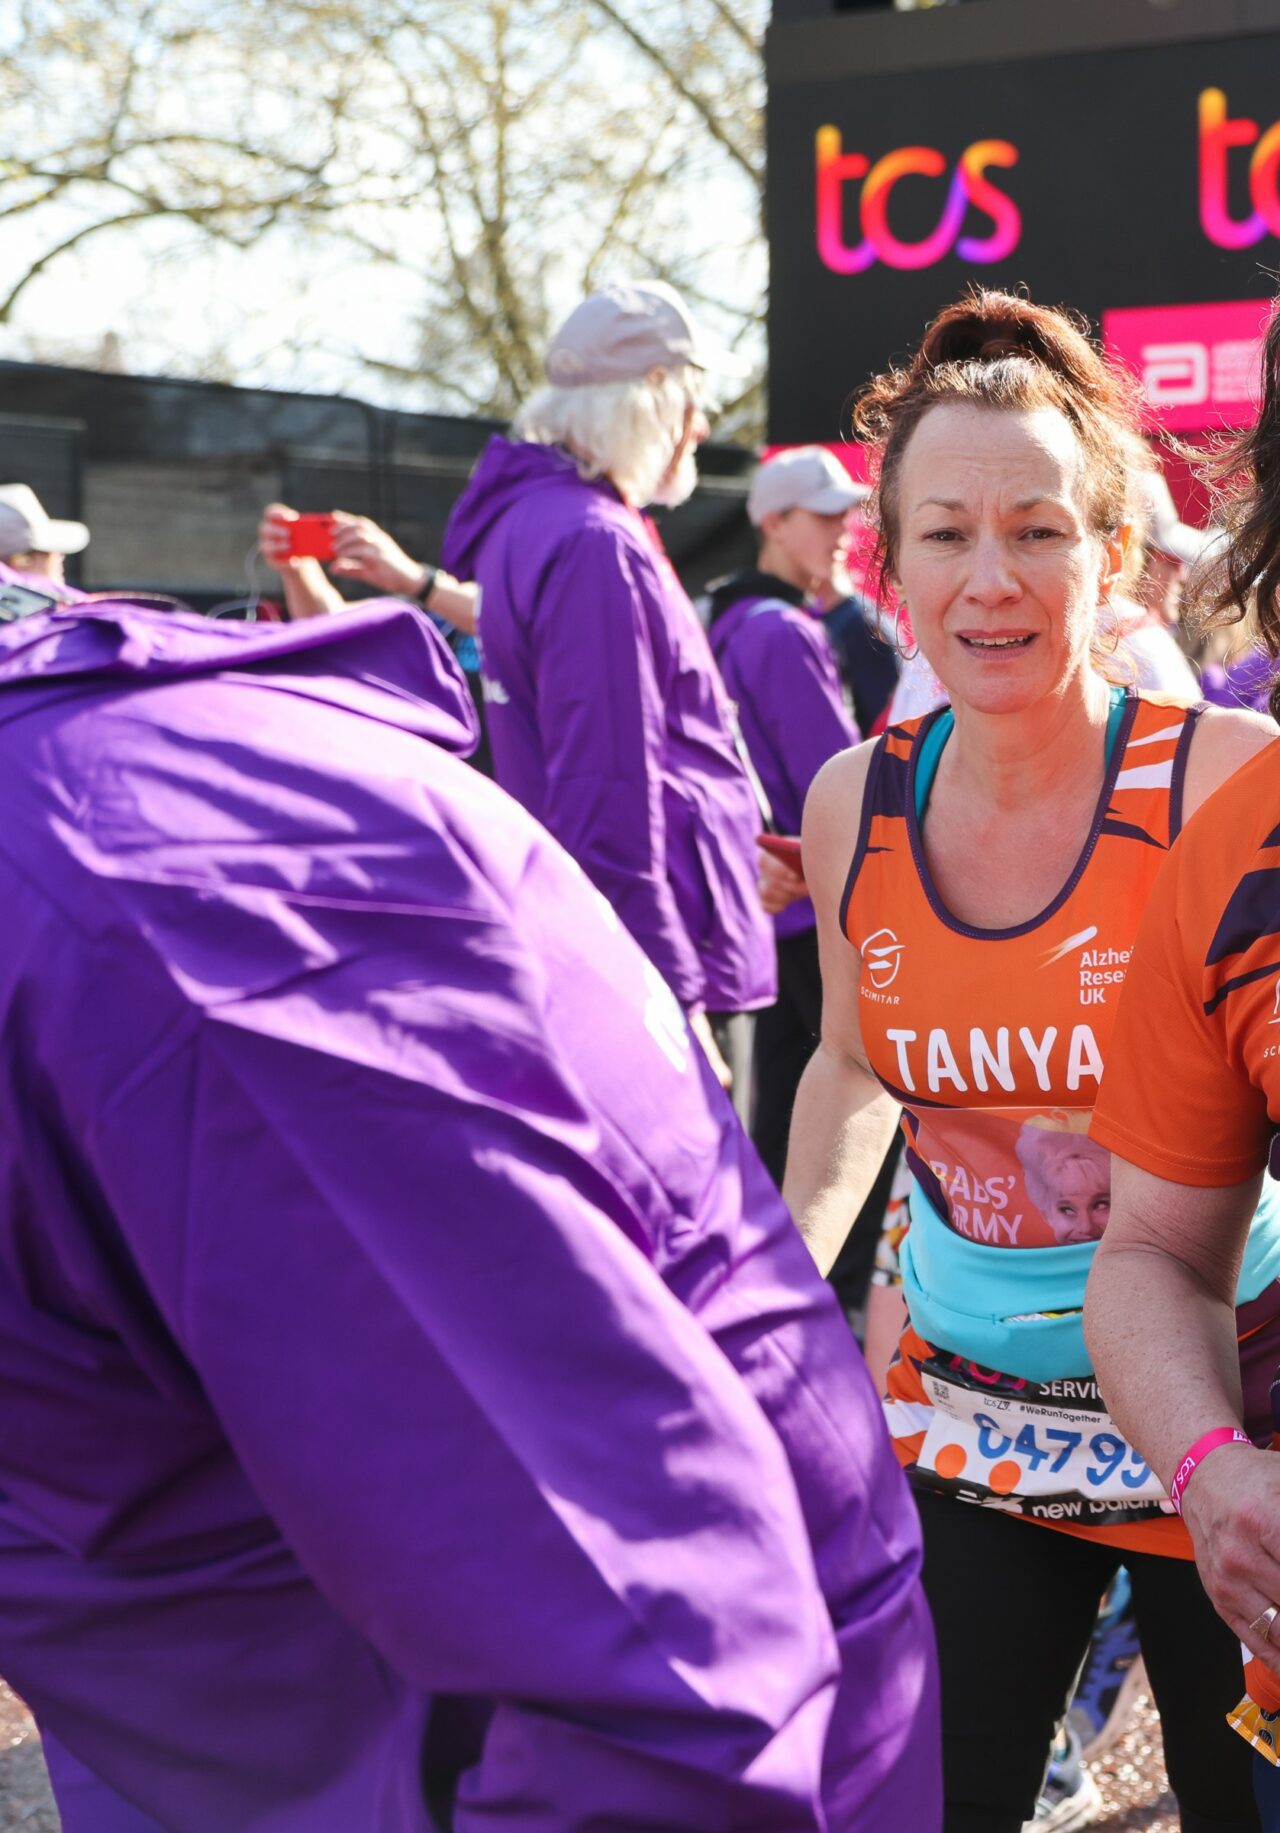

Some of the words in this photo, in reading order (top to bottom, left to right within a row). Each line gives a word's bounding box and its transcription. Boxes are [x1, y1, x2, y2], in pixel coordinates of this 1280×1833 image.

[815, 124, 1022, 274] tcs
[1080, 970, 1127, 986] Rese
[861, 986, 900, 1005] SCIMITAR
[1080, 988, 1106, 1005] UK
[886, 1024, 1105, 1092] TANYA
[1020, 1405, 1102, 1424] #WeRunTogether
[1032, 1501, 1083, 1520] new
